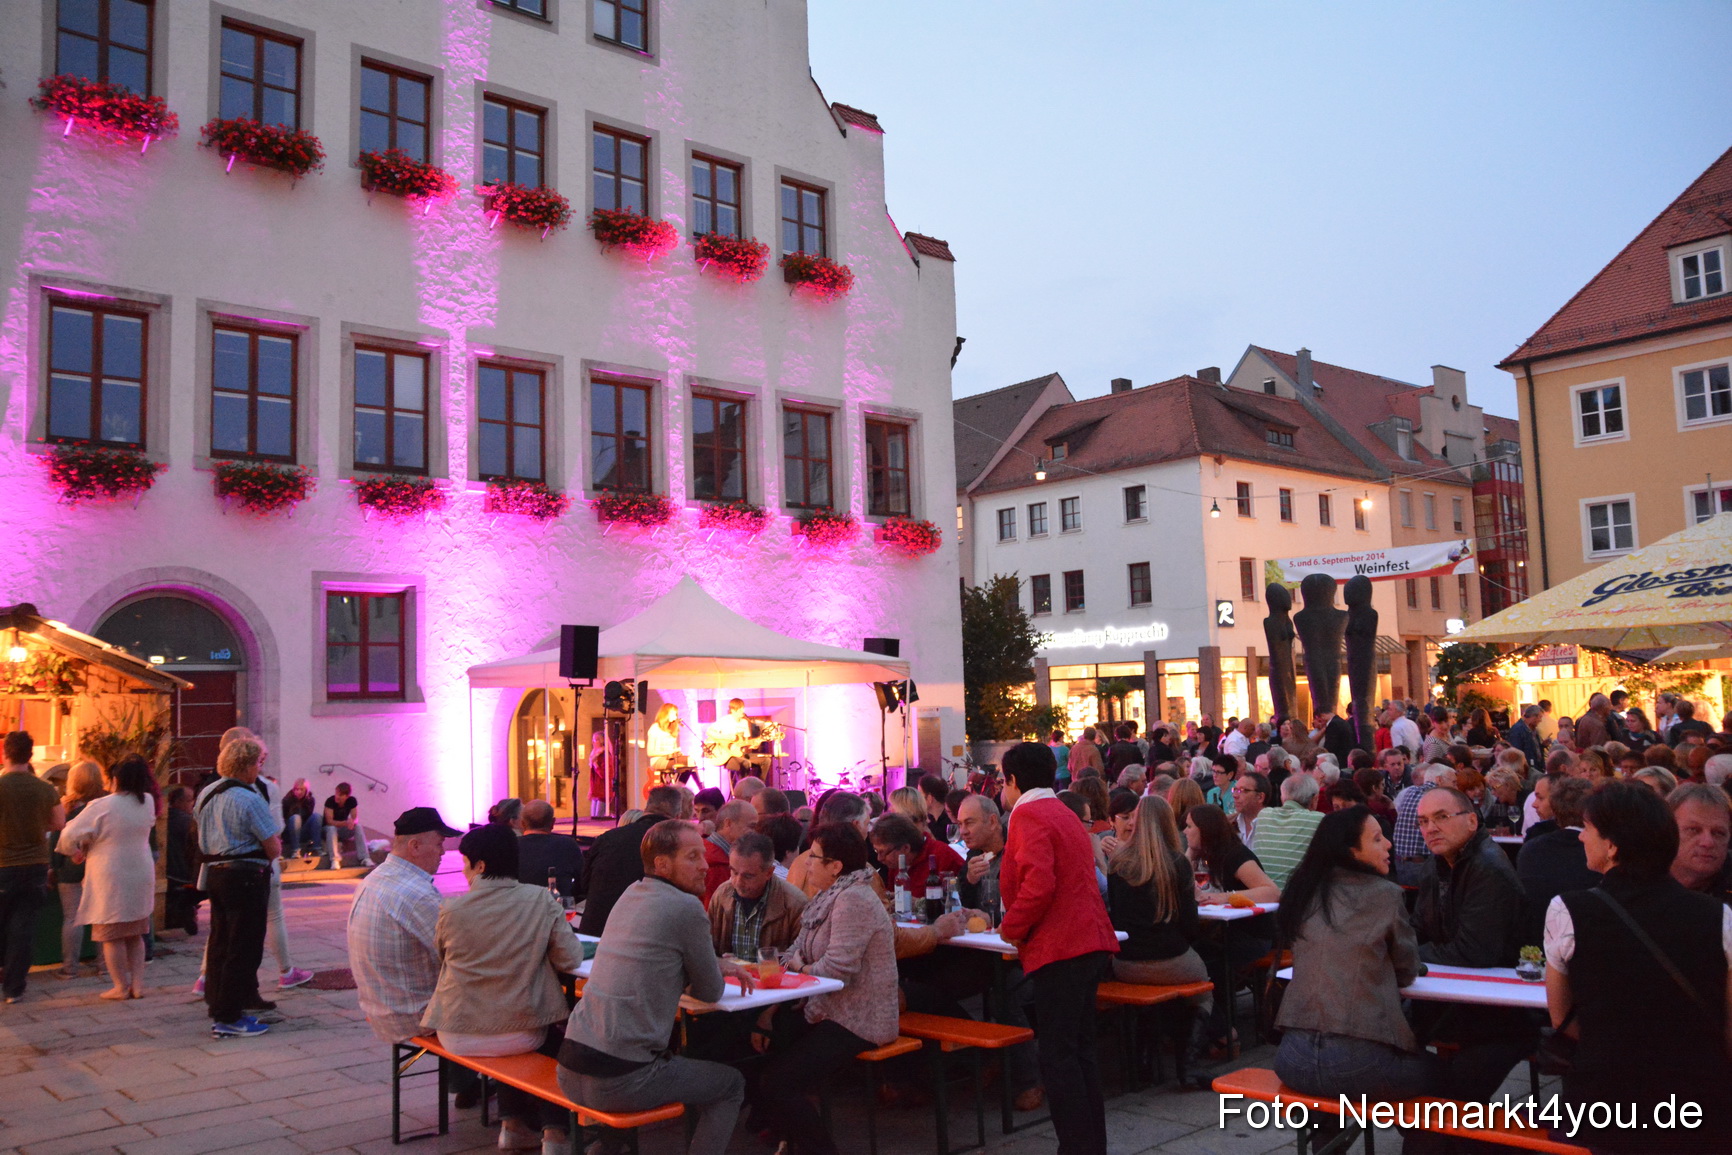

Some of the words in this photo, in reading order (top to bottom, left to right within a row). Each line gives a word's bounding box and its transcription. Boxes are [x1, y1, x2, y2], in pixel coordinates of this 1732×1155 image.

[1321, 555, 1365, 566] September
[1366, 552, 1385, 560] 2014
[1354, 560, 1410, 575] Weinfest
[1667, 581, 1732, 599] Bie
[1217, 601, 1234, 624] R
[1104, 622, 1168, 647] Rupprecht
[1538, 657, 1574, 665] WEIN-DEPOT
